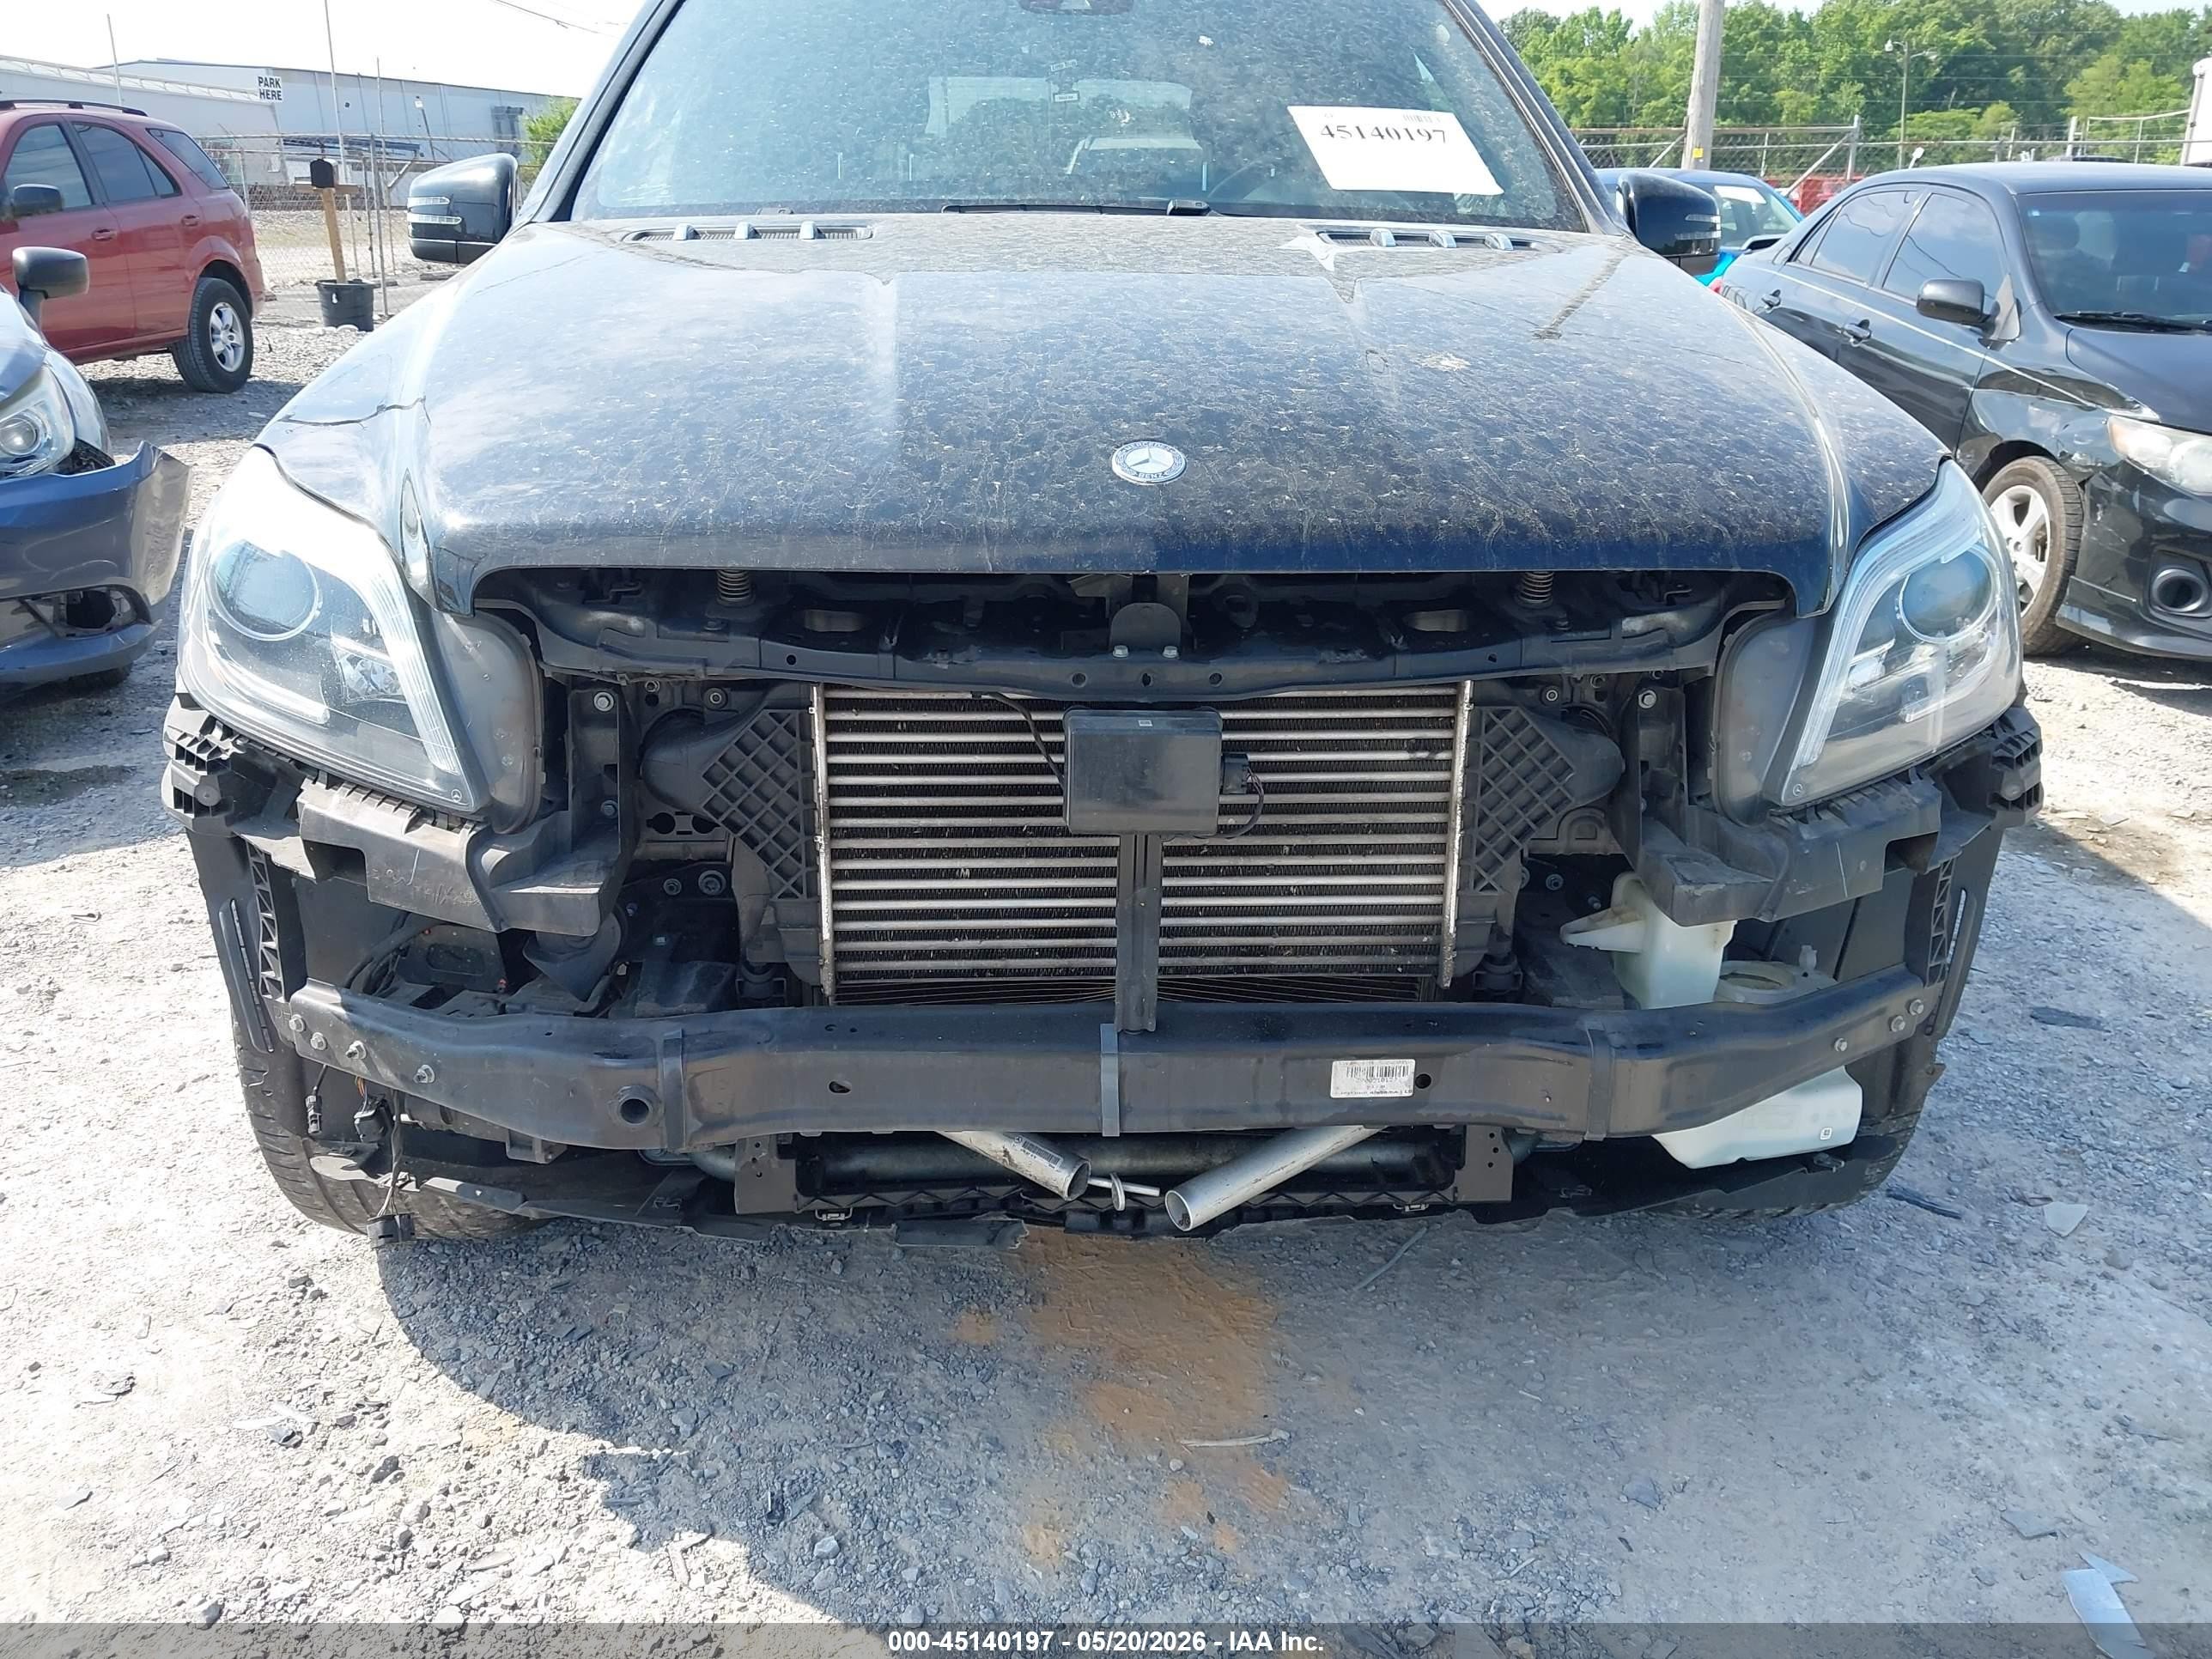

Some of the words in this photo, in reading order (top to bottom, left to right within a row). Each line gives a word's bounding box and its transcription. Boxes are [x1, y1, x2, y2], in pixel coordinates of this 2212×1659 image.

[258, 76, 282, 88] PARK
[259, 88, 283, 100] HERE
[1321, 124, 1446, 143] 45140197
